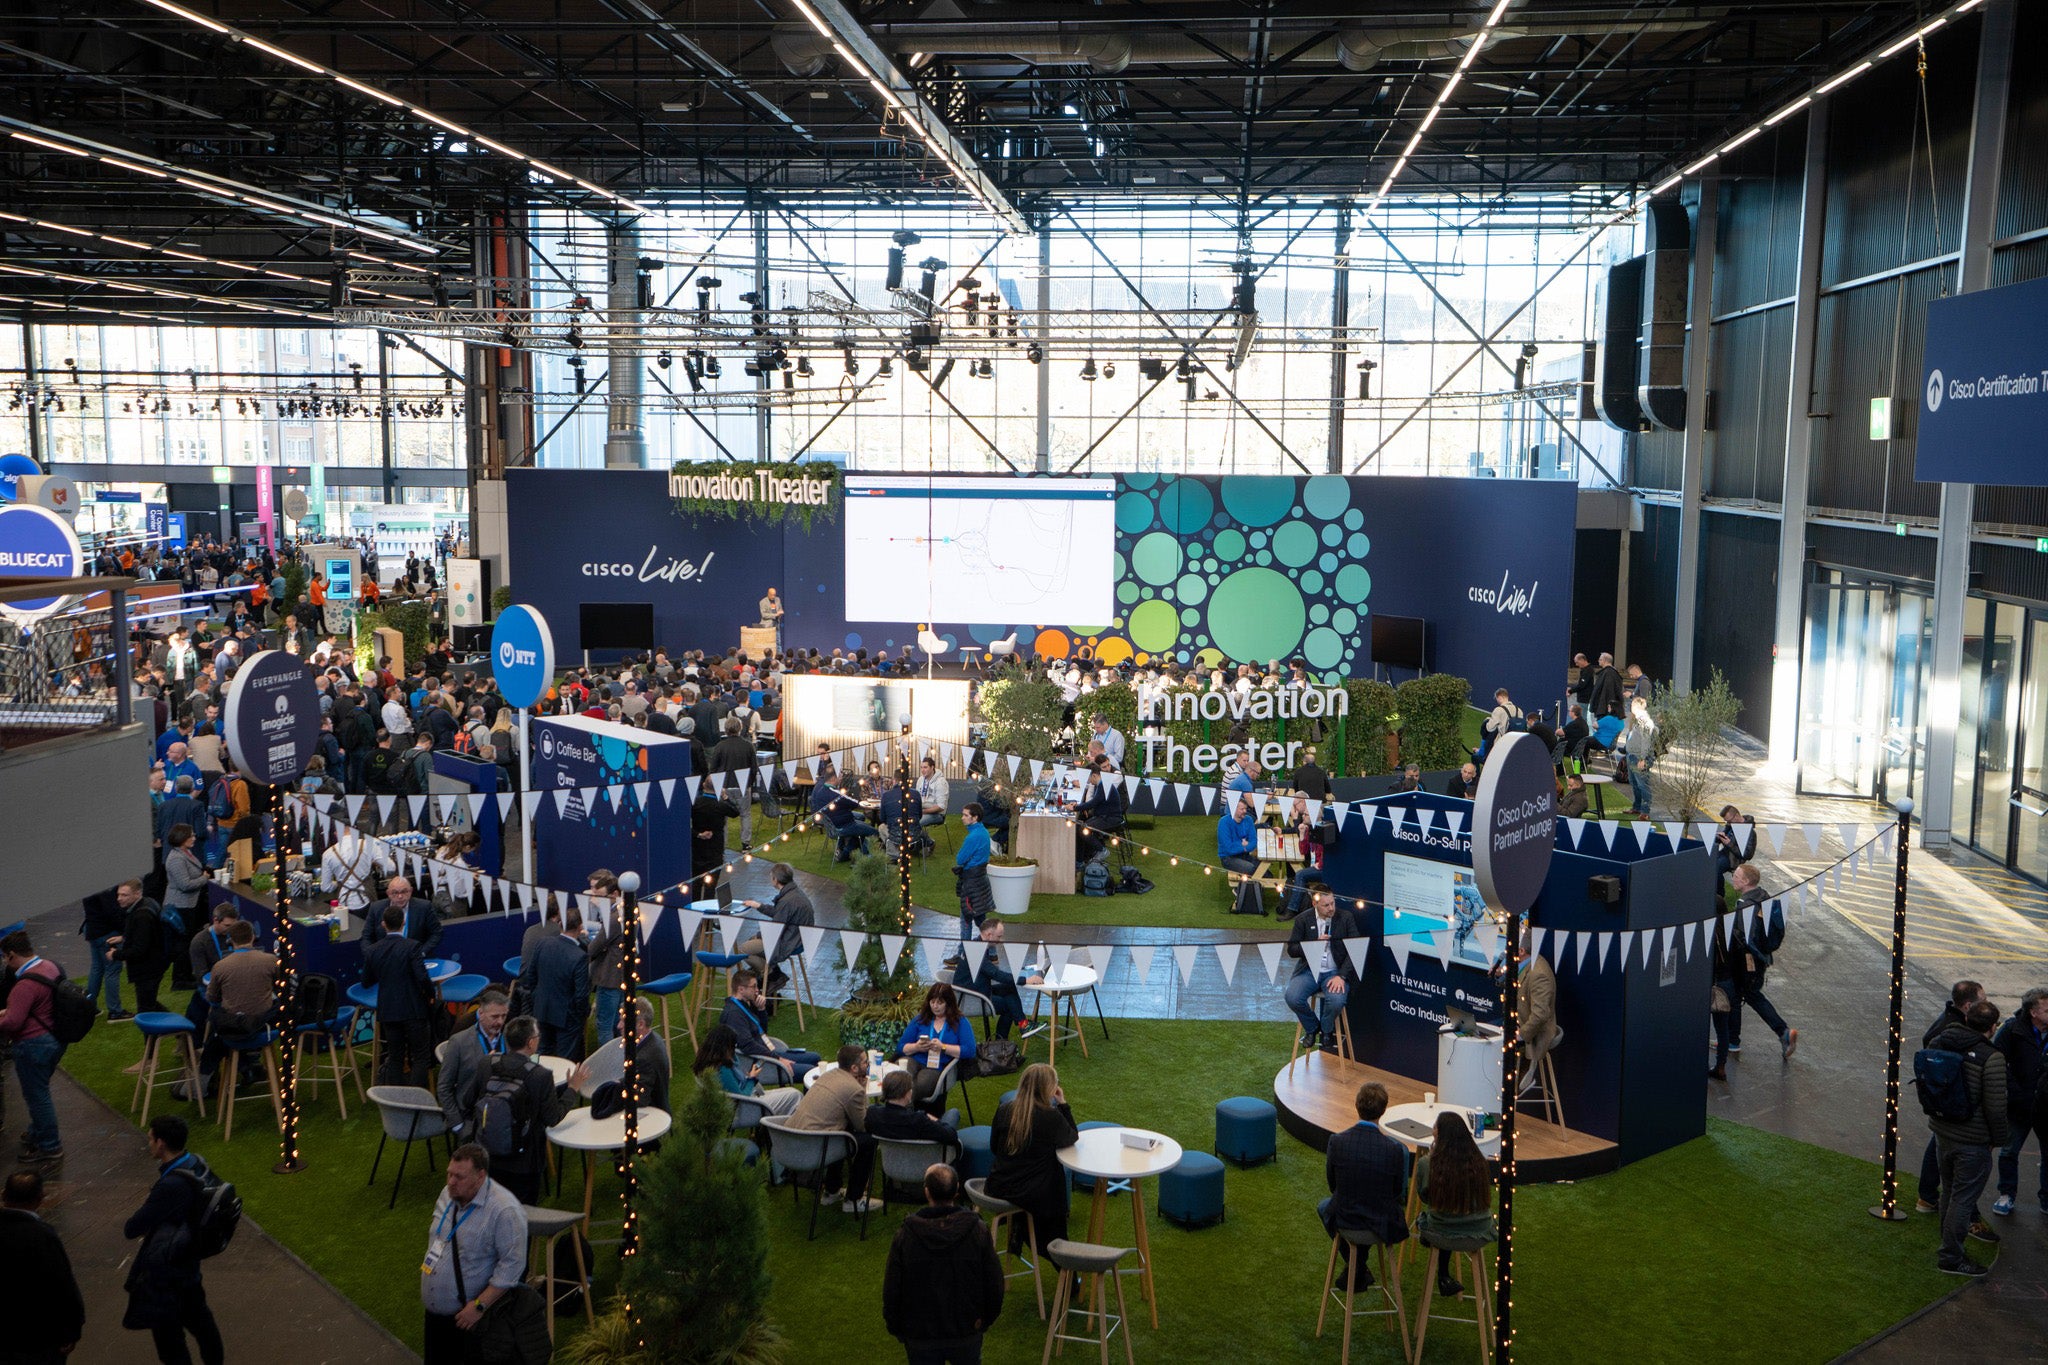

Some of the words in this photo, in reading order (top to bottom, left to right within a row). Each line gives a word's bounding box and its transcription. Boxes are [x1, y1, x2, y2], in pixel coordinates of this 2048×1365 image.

[1949, 379, 1975, 400] Cisco
[1977, 373, 2038, 397] Certification
[668, 467, 754, 501] Innovation
[755, 469, 832, 505] Theater
[0, 553, 66, 567] BLUECAT
[638, 545, 715, 583] Live!
[1496, 569, 1538, 618] Live!
[515, 650, 536, 666] NTT
[252, 670, 302, 688] EVERYANGLE
[1137, 683, 1349, 721] Innovation
[557, 741, 591, 760] Coffee
[583, 748, 597, 763] Bar
[1135, 736, 1302, 773] Theater
[269, 757, 297, 775] METSI
[1497, 807, 1520, 827] Cisco
[1521, 792, 1551, 818] Co-Sell
[1392, 828, 1420, 843] Cisco
[1422, 834, 1460, 851] Co-Sell
[1494, 828, 1523, 852] Partner
[1524, 818, 1552, 840] Lounge
[1390, 973, 1447, 996] EVERYANGLE
[1390, 999, 1416, 1016] Cisco
